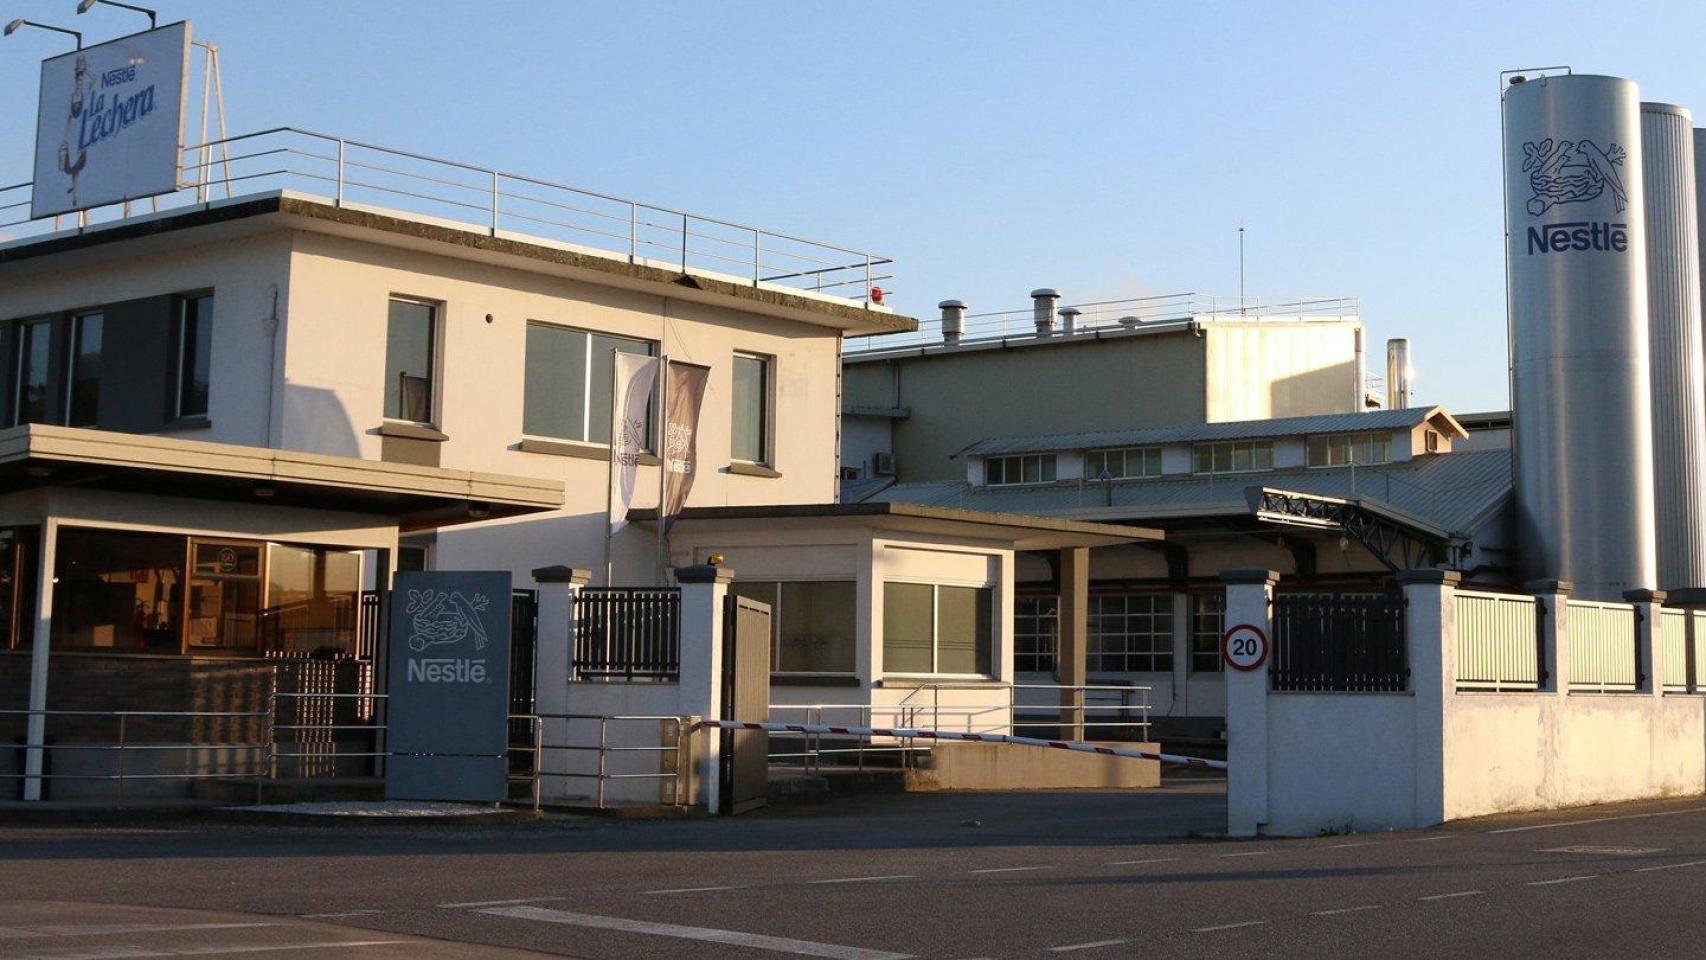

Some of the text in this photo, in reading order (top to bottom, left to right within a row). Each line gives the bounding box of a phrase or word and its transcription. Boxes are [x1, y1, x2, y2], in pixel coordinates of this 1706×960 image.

[78, 84, 155, 150] Lechera
[88, 90, 105, 117] La
[1527, 222, 1628, 255] Nestlé
[1233, 638, 1258, 656] 20
[407, 658, 486, 683] Nestlé
